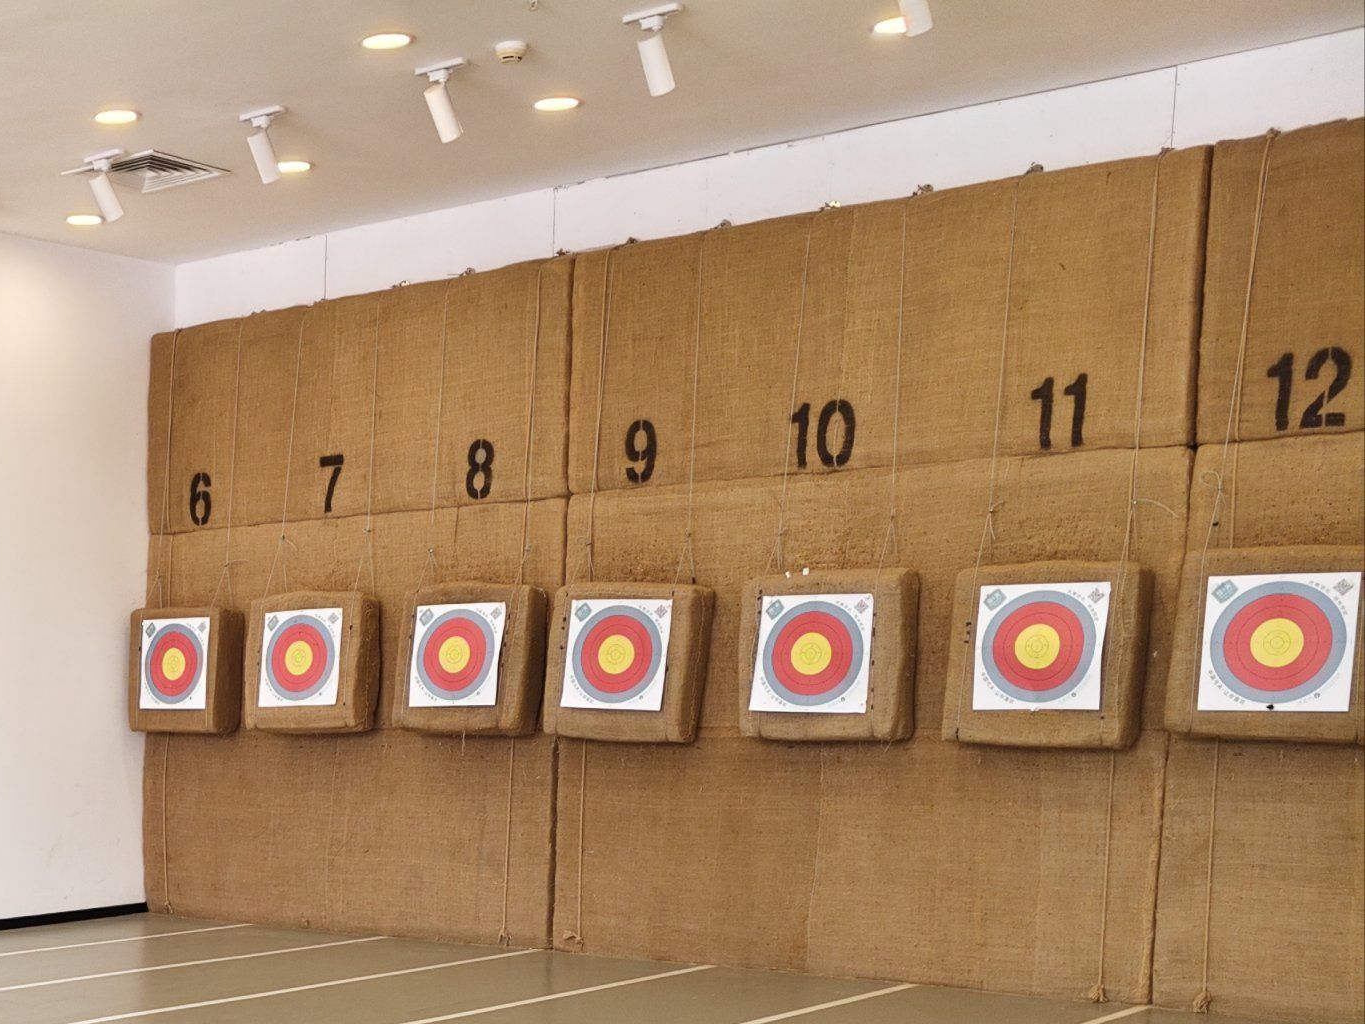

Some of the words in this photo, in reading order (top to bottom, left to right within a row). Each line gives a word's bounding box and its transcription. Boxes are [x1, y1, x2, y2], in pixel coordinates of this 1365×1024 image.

[1030, 373, 1088, 450] 11
[1266, 346, 1353, 432] 12
[624, 419, 657, 484] 9
[791, 399, 856, 468] 10
[189, 472, 212, 526] 6
[319, 454, 344, 514] 7
[465, 439, 495, 500] 8
